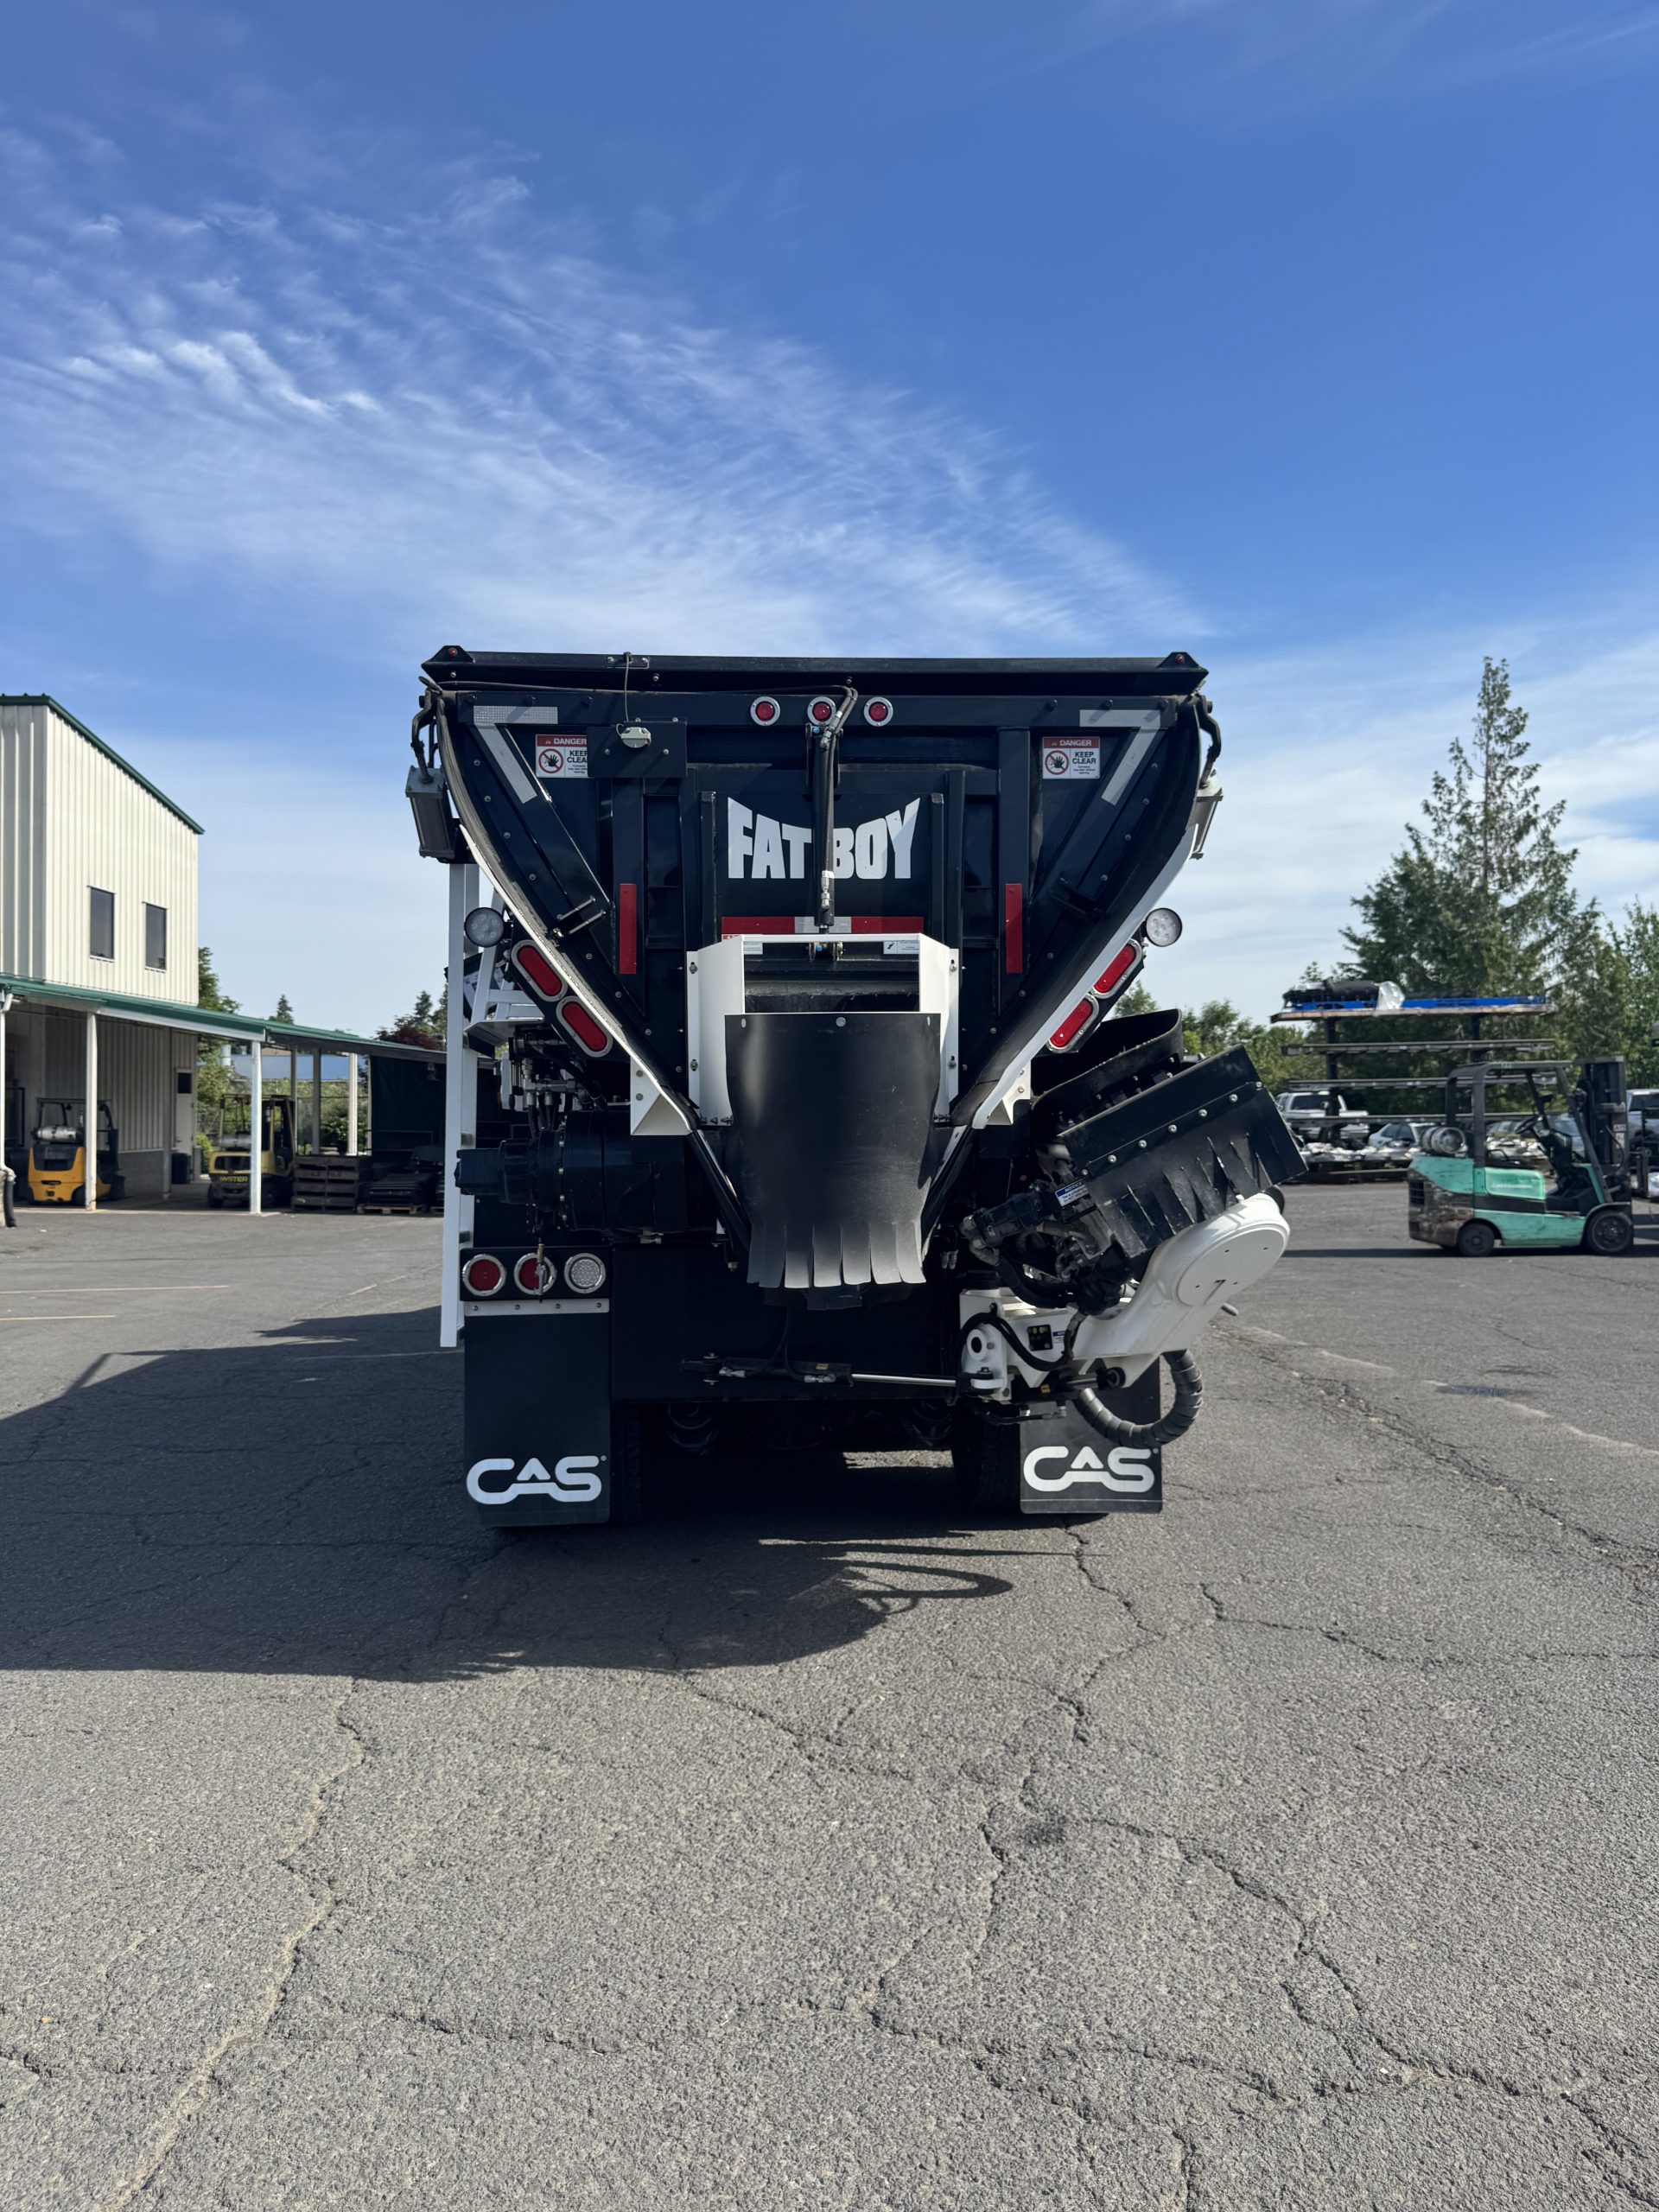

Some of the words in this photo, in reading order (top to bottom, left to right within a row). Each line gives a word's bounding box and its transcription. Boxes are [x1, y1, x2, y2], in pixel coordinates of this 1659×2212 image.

[728, 797, 812, 879] FAT
[833, 798, 921, 880] BOY
[467, 1455, 602, 1505] CAS
[1023, 1446, 1155, 1493] CAS
